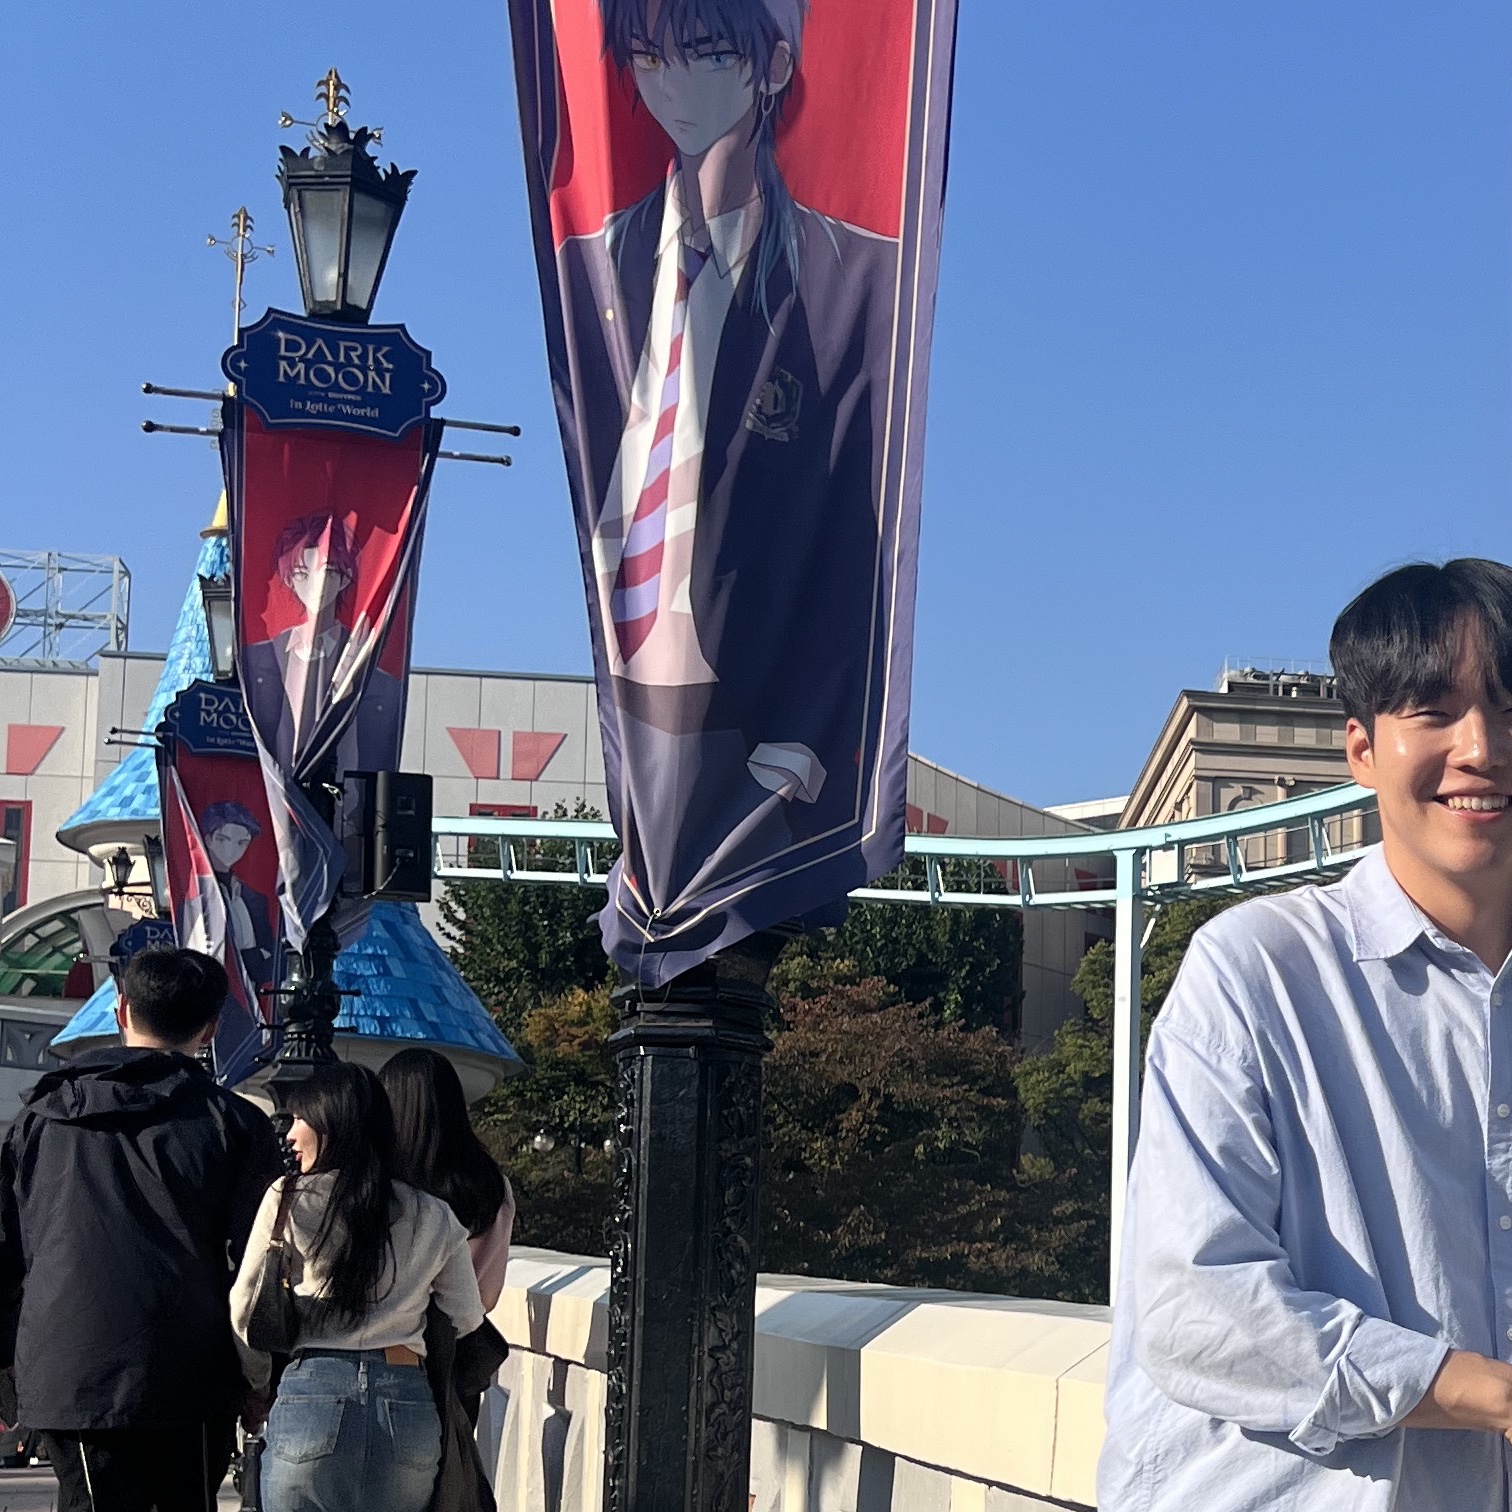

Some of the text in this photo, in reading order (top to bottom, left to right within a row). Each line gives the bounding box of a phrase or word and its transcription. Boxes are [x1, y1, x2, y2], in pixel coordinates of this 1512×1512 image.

[277, 331, 393, 369] DARK
[278, 358, 391, 394] MOON
[338, 403, 379, 418] World
[199, 692, 243, 713] DA
